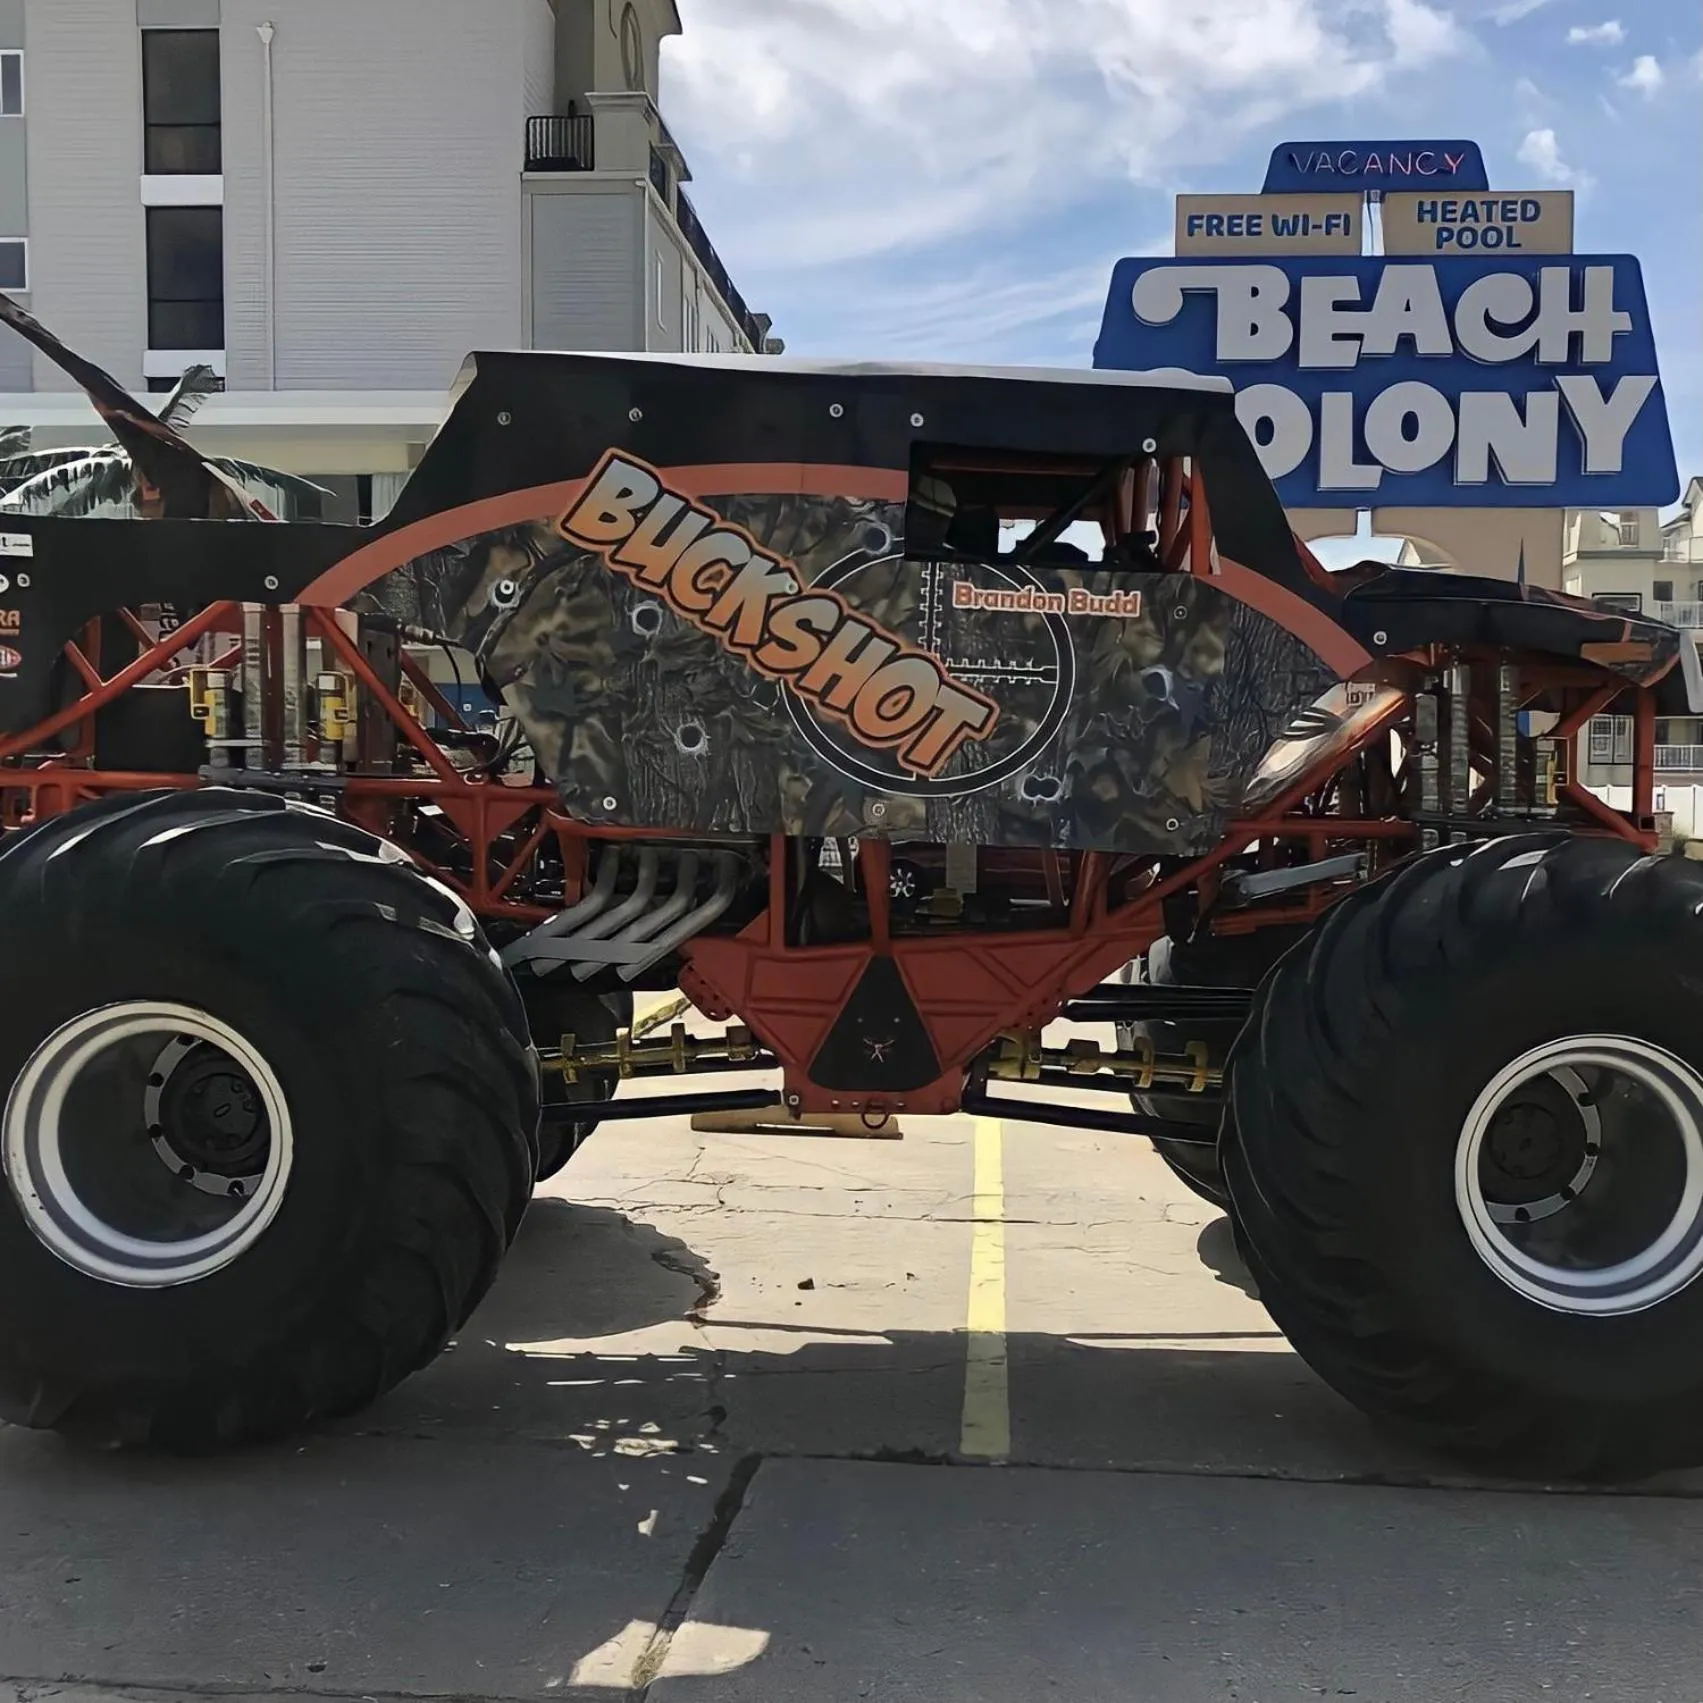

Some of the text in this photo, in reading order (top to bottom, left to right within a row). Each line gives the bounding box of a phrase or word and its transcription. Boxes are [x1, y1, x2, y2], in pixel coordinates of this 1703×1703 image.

[1289, 149, 1465, 176] VACANCY
[1187, 213, 1351, 237] FREE WI-FI
[1417, 200, 1541, 224] HEATED
[1435, 226, 1522, 250] POOL
[1132, 264, 1634, 369] BEACH
[1146, 367, 1658, 491] OLONY
[559, 448, 998, 778] BUCKSHOT
[953, 581, 1141, 617] Brandon Budd
